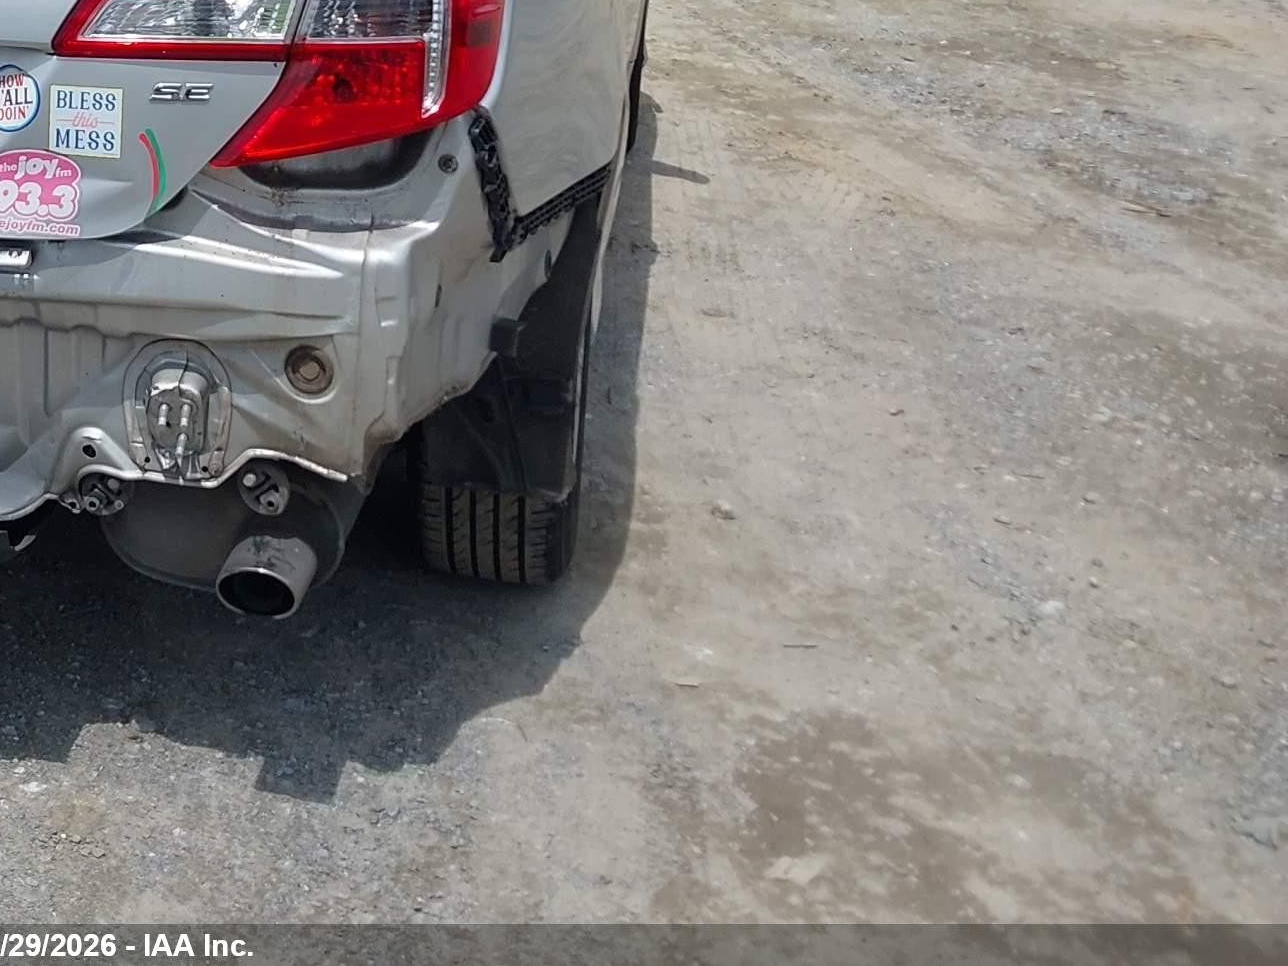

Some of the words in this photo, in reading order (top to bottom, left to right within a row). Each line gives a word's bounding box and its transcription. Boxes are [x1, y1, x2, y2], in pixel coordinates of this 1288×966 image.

[56, 90, 117, 111] BLESS
[149, 82, 214, 103] SE
[71, 111, 99, 128] this
[55, 128, 116, 151] MESS
